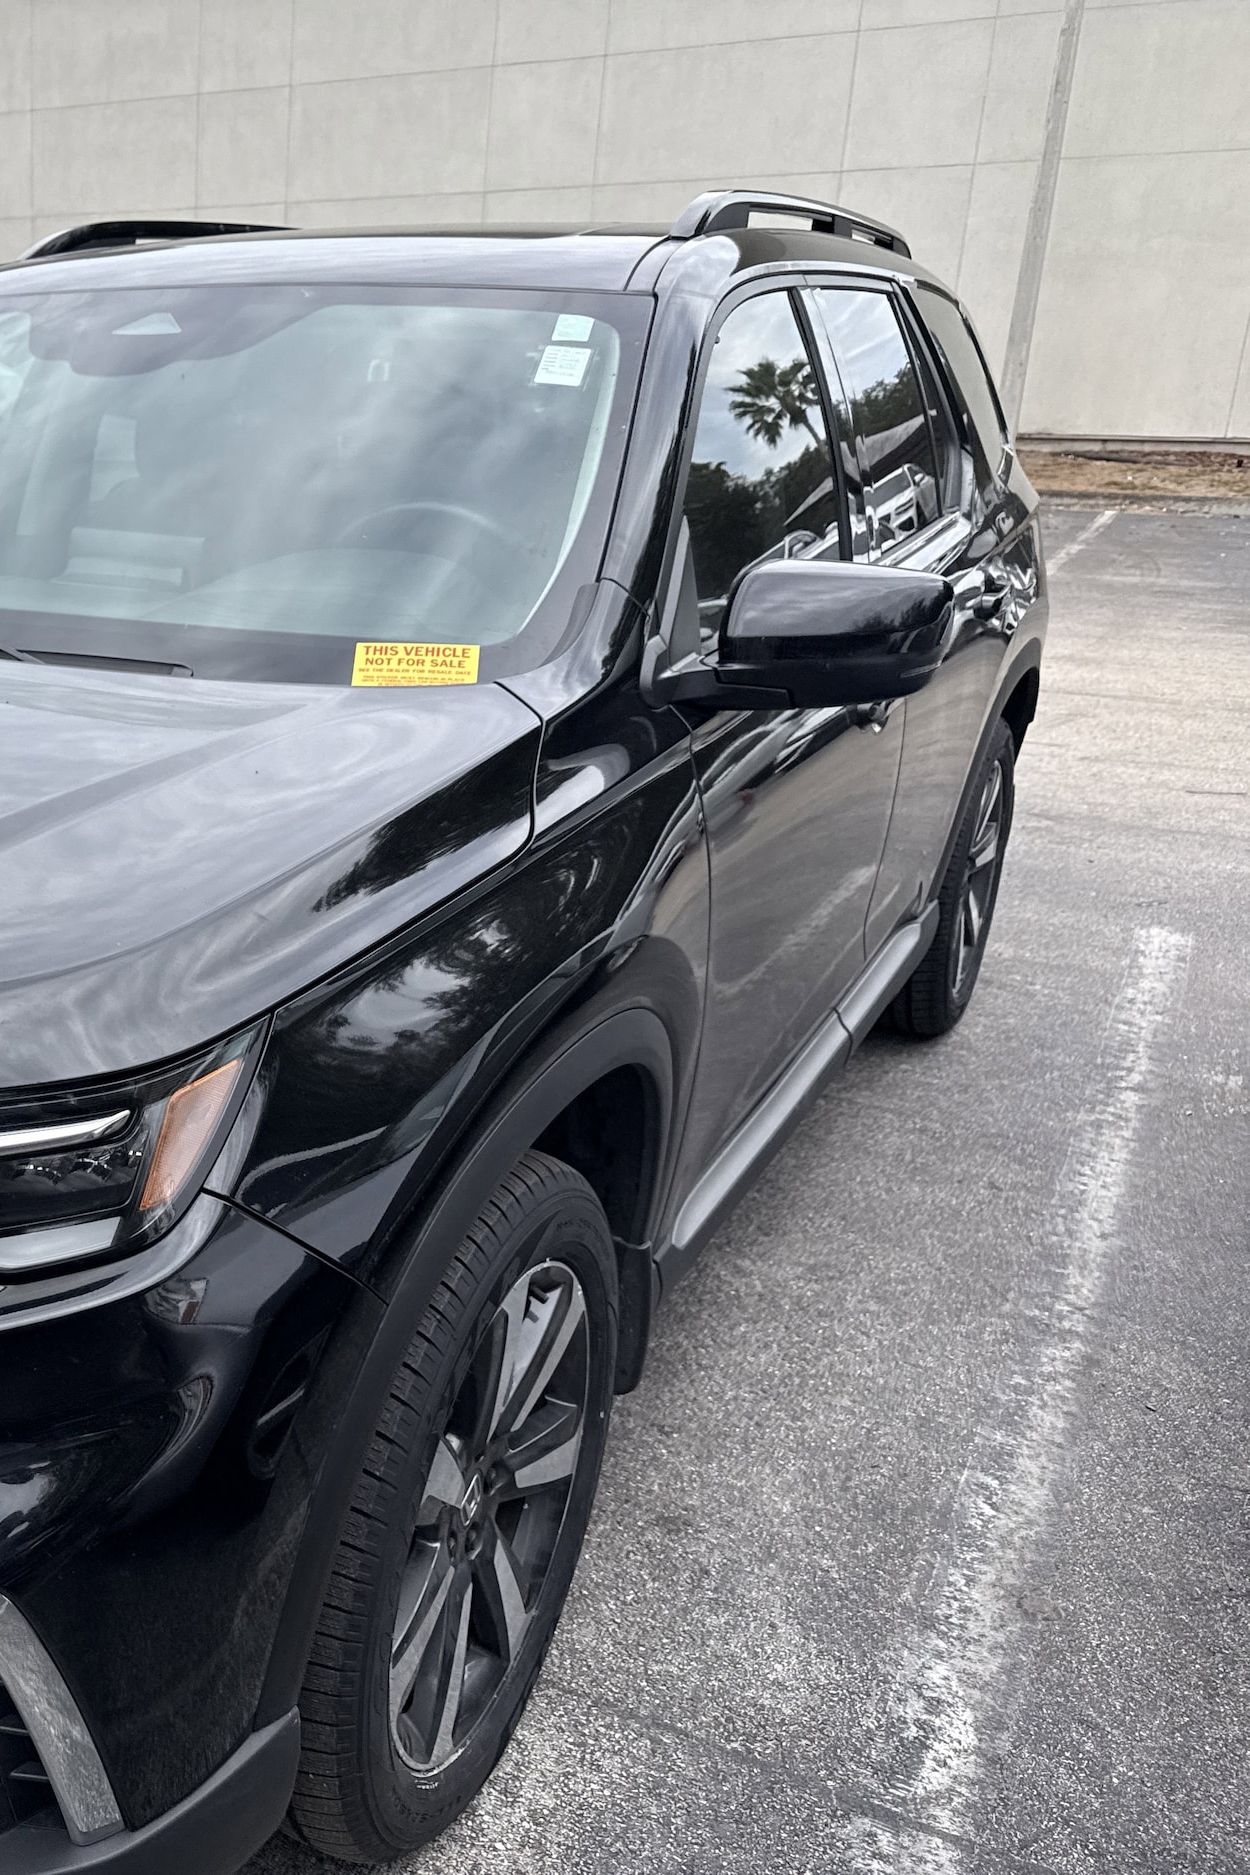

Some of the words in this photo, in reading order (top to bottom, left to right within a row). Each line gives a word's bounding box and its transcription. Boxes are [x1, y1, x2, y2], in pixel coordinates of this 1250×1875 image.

[363, 645, 399, 656] THIS
[403, 646, 471, 658] VEHICLE
[365, 657, 393, 666] NOT
[397, 658, 425, 667] FOR
[430, 659, 466, 669] SALE
